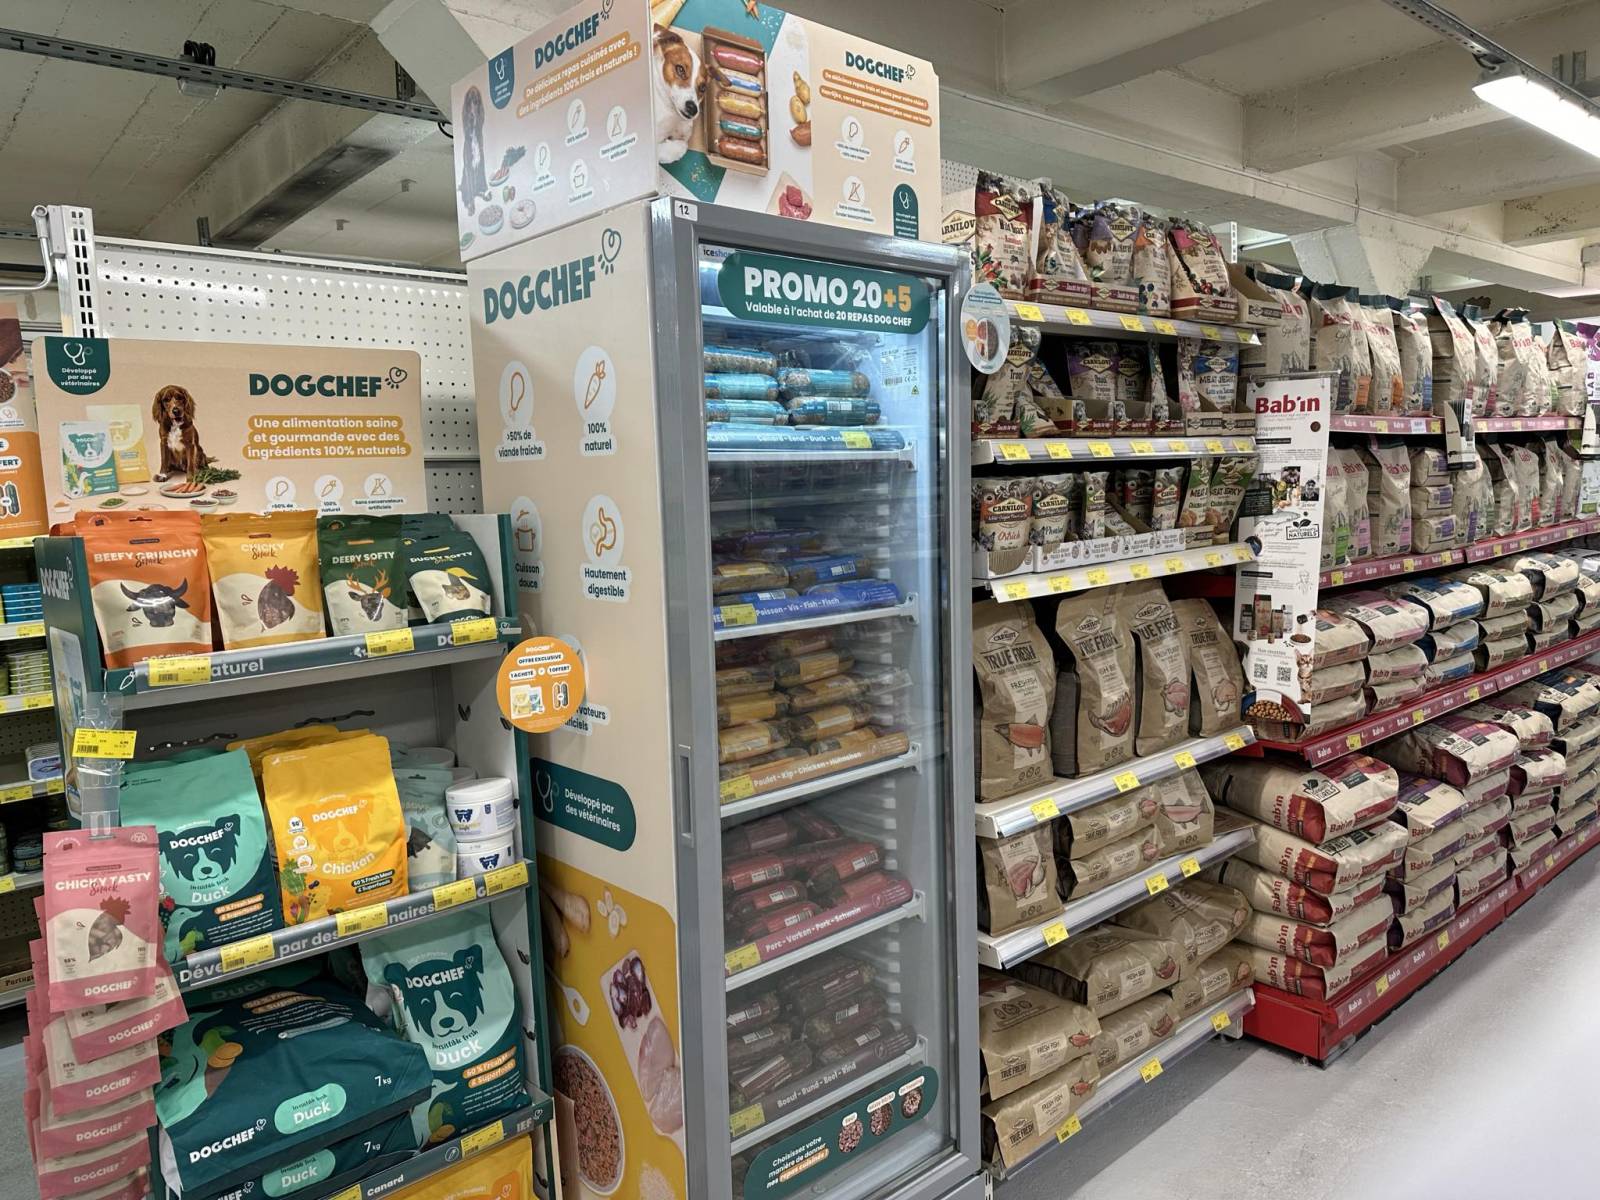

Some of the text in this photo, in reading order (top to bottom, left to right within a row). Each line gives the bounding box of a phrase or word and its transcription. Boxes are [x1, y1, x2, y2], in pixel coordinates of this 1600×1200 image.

[534, 13, 601, 69] DOGCHEF
[561, 62, 580, 80] repas
[579, 47, 608, 69] cuisinés
[607, 37, 627, 54] avec
[846, 50, 905, 83] DOGCHEF
[563, 77, 580, 94] 100%
[579, 67, 596, 87] frais
[596, 63, 604, 77] et
[602, 49, 634, 74] naturels
[678, 202, 691, 216] 12
[703, 249, 729, 258] icesho
[483, 254, 596, 325] DOGCHEF
[743, 266, 848, 306] PROMO
[745, 300, 912, 327] Valable à l'achat de 20 REPAS DOG CHEF
[61, 367, 97, 375] Développé
[67, 374, 80, 382] par
[248, 373, 382, 398] DOGCHEF
[1254, 394, 1321, 415] Bab'in
[253, 417, 399, 429] Une alimentation saine
[587, 422, 607, 434] 100%
[253, 431, 400, 446] et gourmande avec des
[523, 429, 532, 440] de
[584, 438, 612, 452] naturel
[247, 446, 408, 460] ingrédients 100% naturels
[498, 447, 520, 458] viande
[93, 548, 199, 564] BEEFY CRUNCHY
[240, 543, 285, 553] CHICKY
[252, 547, 278, 560] Snack
[332, 551, 396, 565] DEERY SOFTY
[409, 553, 443, 564] DUCKY
[514, 562, 540, 575] Cuisson
[584, 567, 627, 581] Hautement
[518, 577, 539, 589] douce
[587, 583, 625, 598] digestible
[755, 597, 841, 618] Poisson Vis Fish Fisch
[518, 654, 562, 665] OFFRE EXCLUSIVE
[984, 645, 1037, 670] TRUE FRESH
[210, 658, 265, 679] aturel
[577, 706, 606, 721] vateurs
[753, 761, 826, 787] Poulet Kip Chicken
[564, 787, 615, 816] Développé par
[312, 805, 359, 823] DOGCHEF
[565, 804, 621, 833] des vétérinaires
[169, 828, 225, 850] DOGCHEF
[322, 852, 376, 875] Chicken
[55, 871, 152, 892] CHICKY TASTY
[191, 886, 231, 904] Duck
[765, 940, 783, 953] Porc
[815, 919, 831, 931] Pork
[834, 906, 862, 923] Schwein
[277, 929, 339, 958] par des
[404, 966, 466, 989] DOGCHEF
[84, 980, 133, 997] DOGCHEF
[108, 1019, 155, 1044] DOGCHEF
[434, 1038, 484, 1067] Duck
[86, 1076, 132, 1099] DOGCHEF
[801, 1082, 819, 1096] Rund
[842, 1063, 857, 1076] Rind
[293, 1101, 332, 1125] Duck
[75, 1121, 123, 1143] DOGCHEF
[189, 1127, 256, 1164] DOGCHEF
[772, 1136, 823, 1168] Choisissez votre
[768, 1143, 827, 1179] manière de donner
[73, 1162, 120, 1184] DOGCHEF
[281, 1165, 319, 1189] Duck
[780, 1170, 799, 1184] repas
